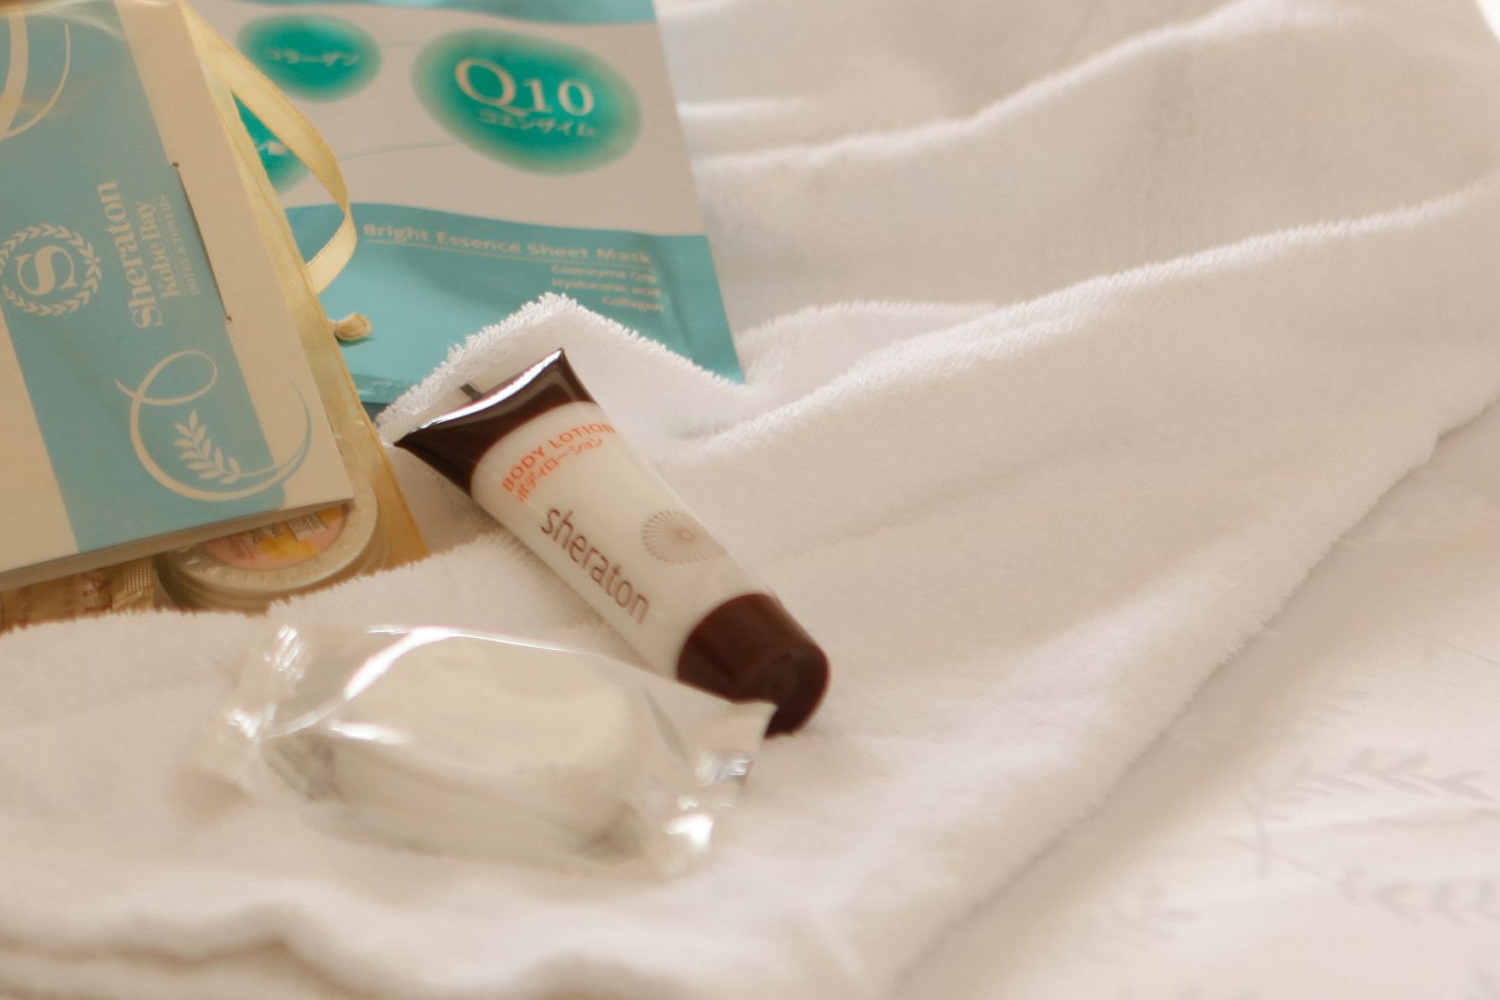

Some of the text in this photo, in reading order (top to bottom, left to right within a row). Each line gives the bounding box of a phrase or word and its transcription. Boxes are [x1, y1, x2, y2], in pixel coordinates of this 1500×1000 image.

[455, 57, 595, 117] Q10
[98, 179, 163, 328] Sheraton
[136, 201, 181, 297] Kobe Bay
[362, 223, 652, 265] Bright Essence Sheet Mask
[502, 423, 617, 492] BODY LOTION
[540, 507, 649, 625] sheraton
